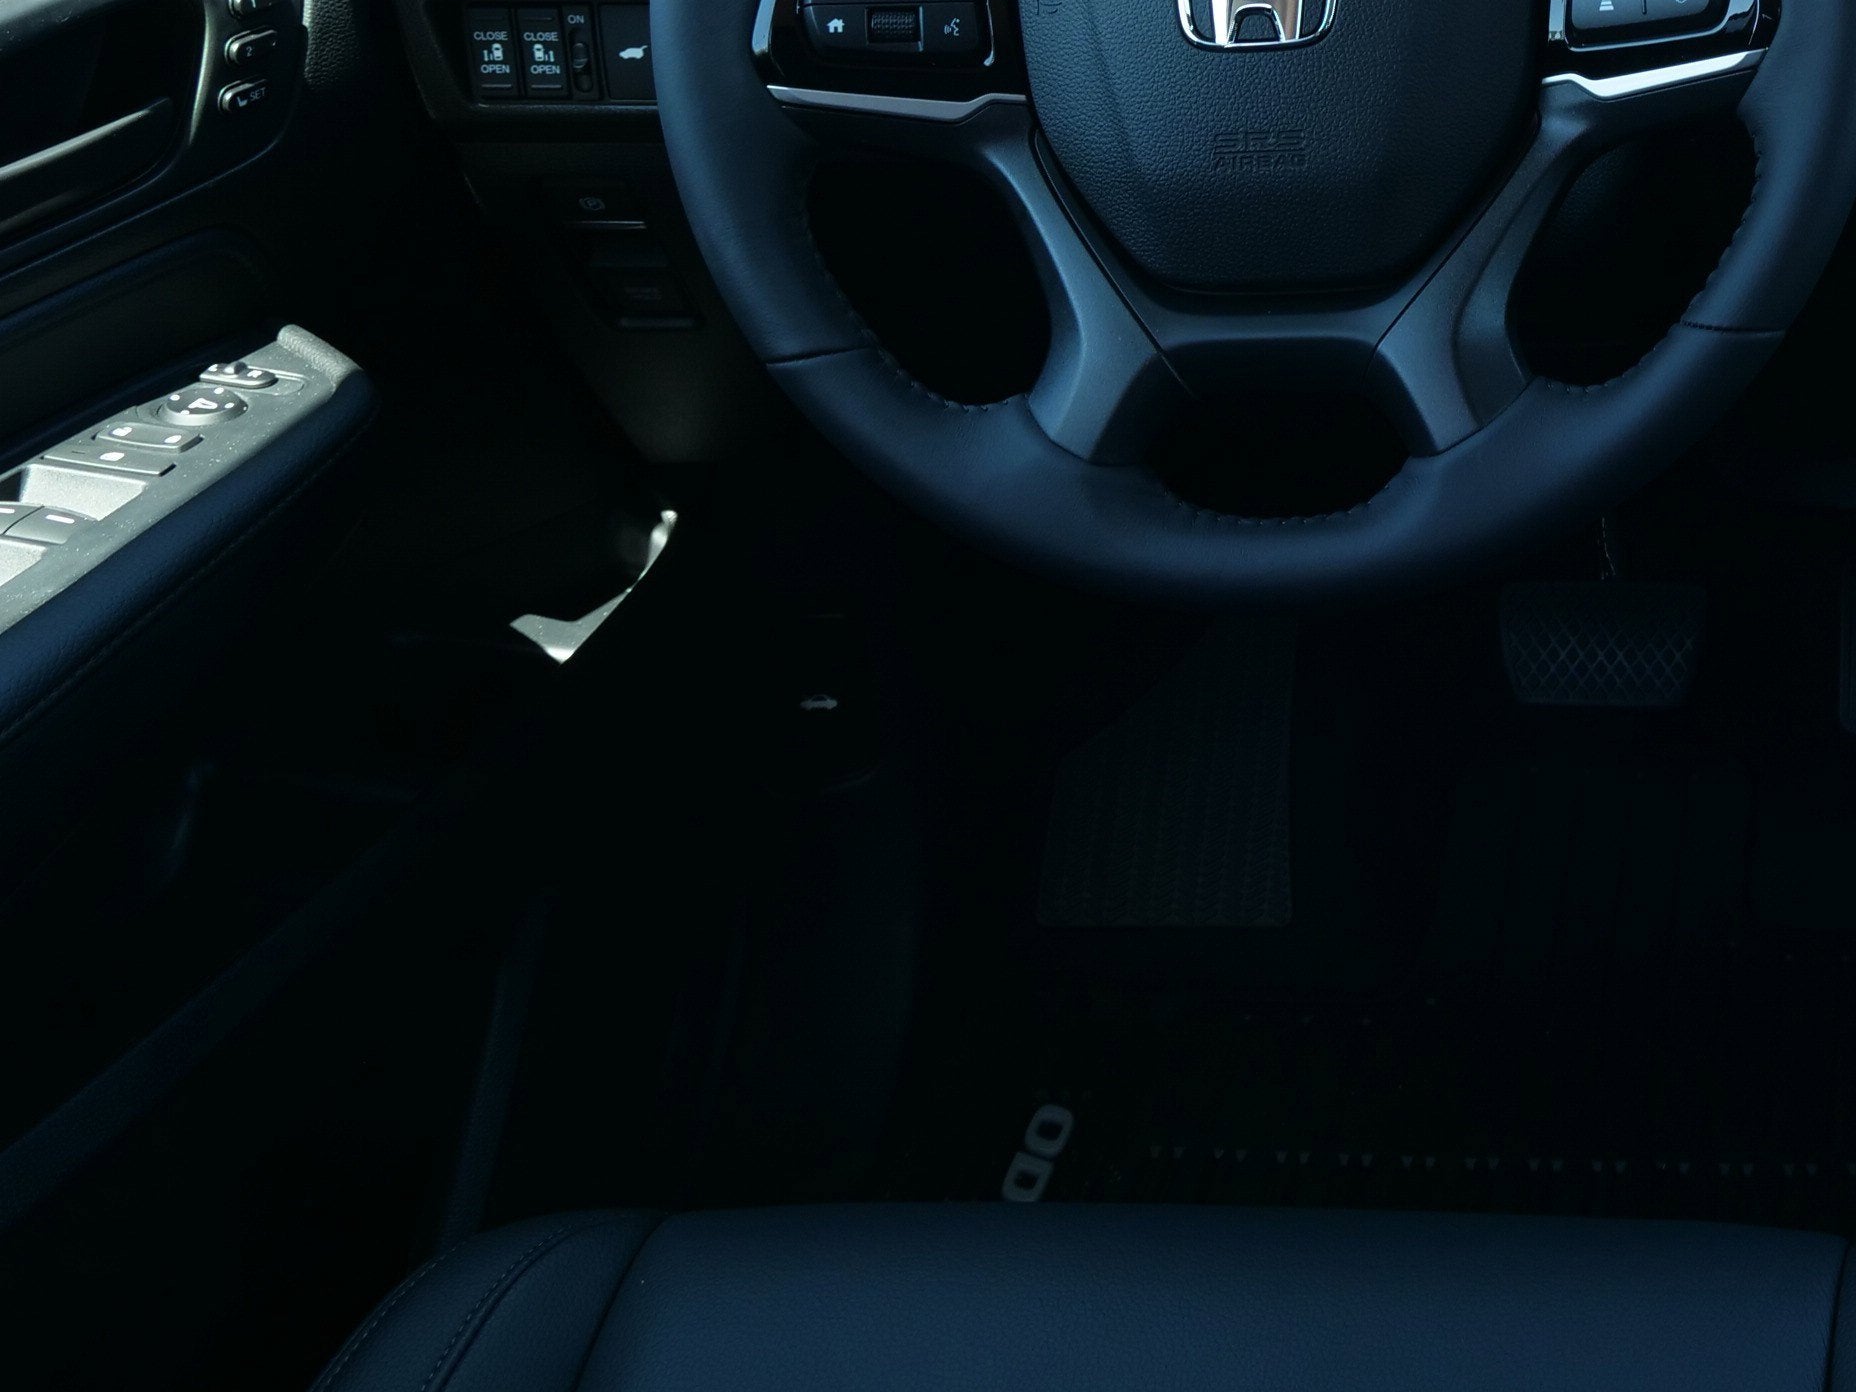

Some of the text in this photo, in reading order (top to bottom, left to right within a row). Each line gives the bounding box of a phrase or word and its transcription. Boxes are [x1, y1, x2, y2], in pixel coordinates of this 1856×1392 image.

[567, 15, 584, 24] ON
[473, 31, 508, 41] CLOSE
[523, 32, 558, 42] CLOSE
[481, 64, 510, 74] OPEN
[531, 65, 560, 74] OPEN
[250, 87, 266, 100] SET
